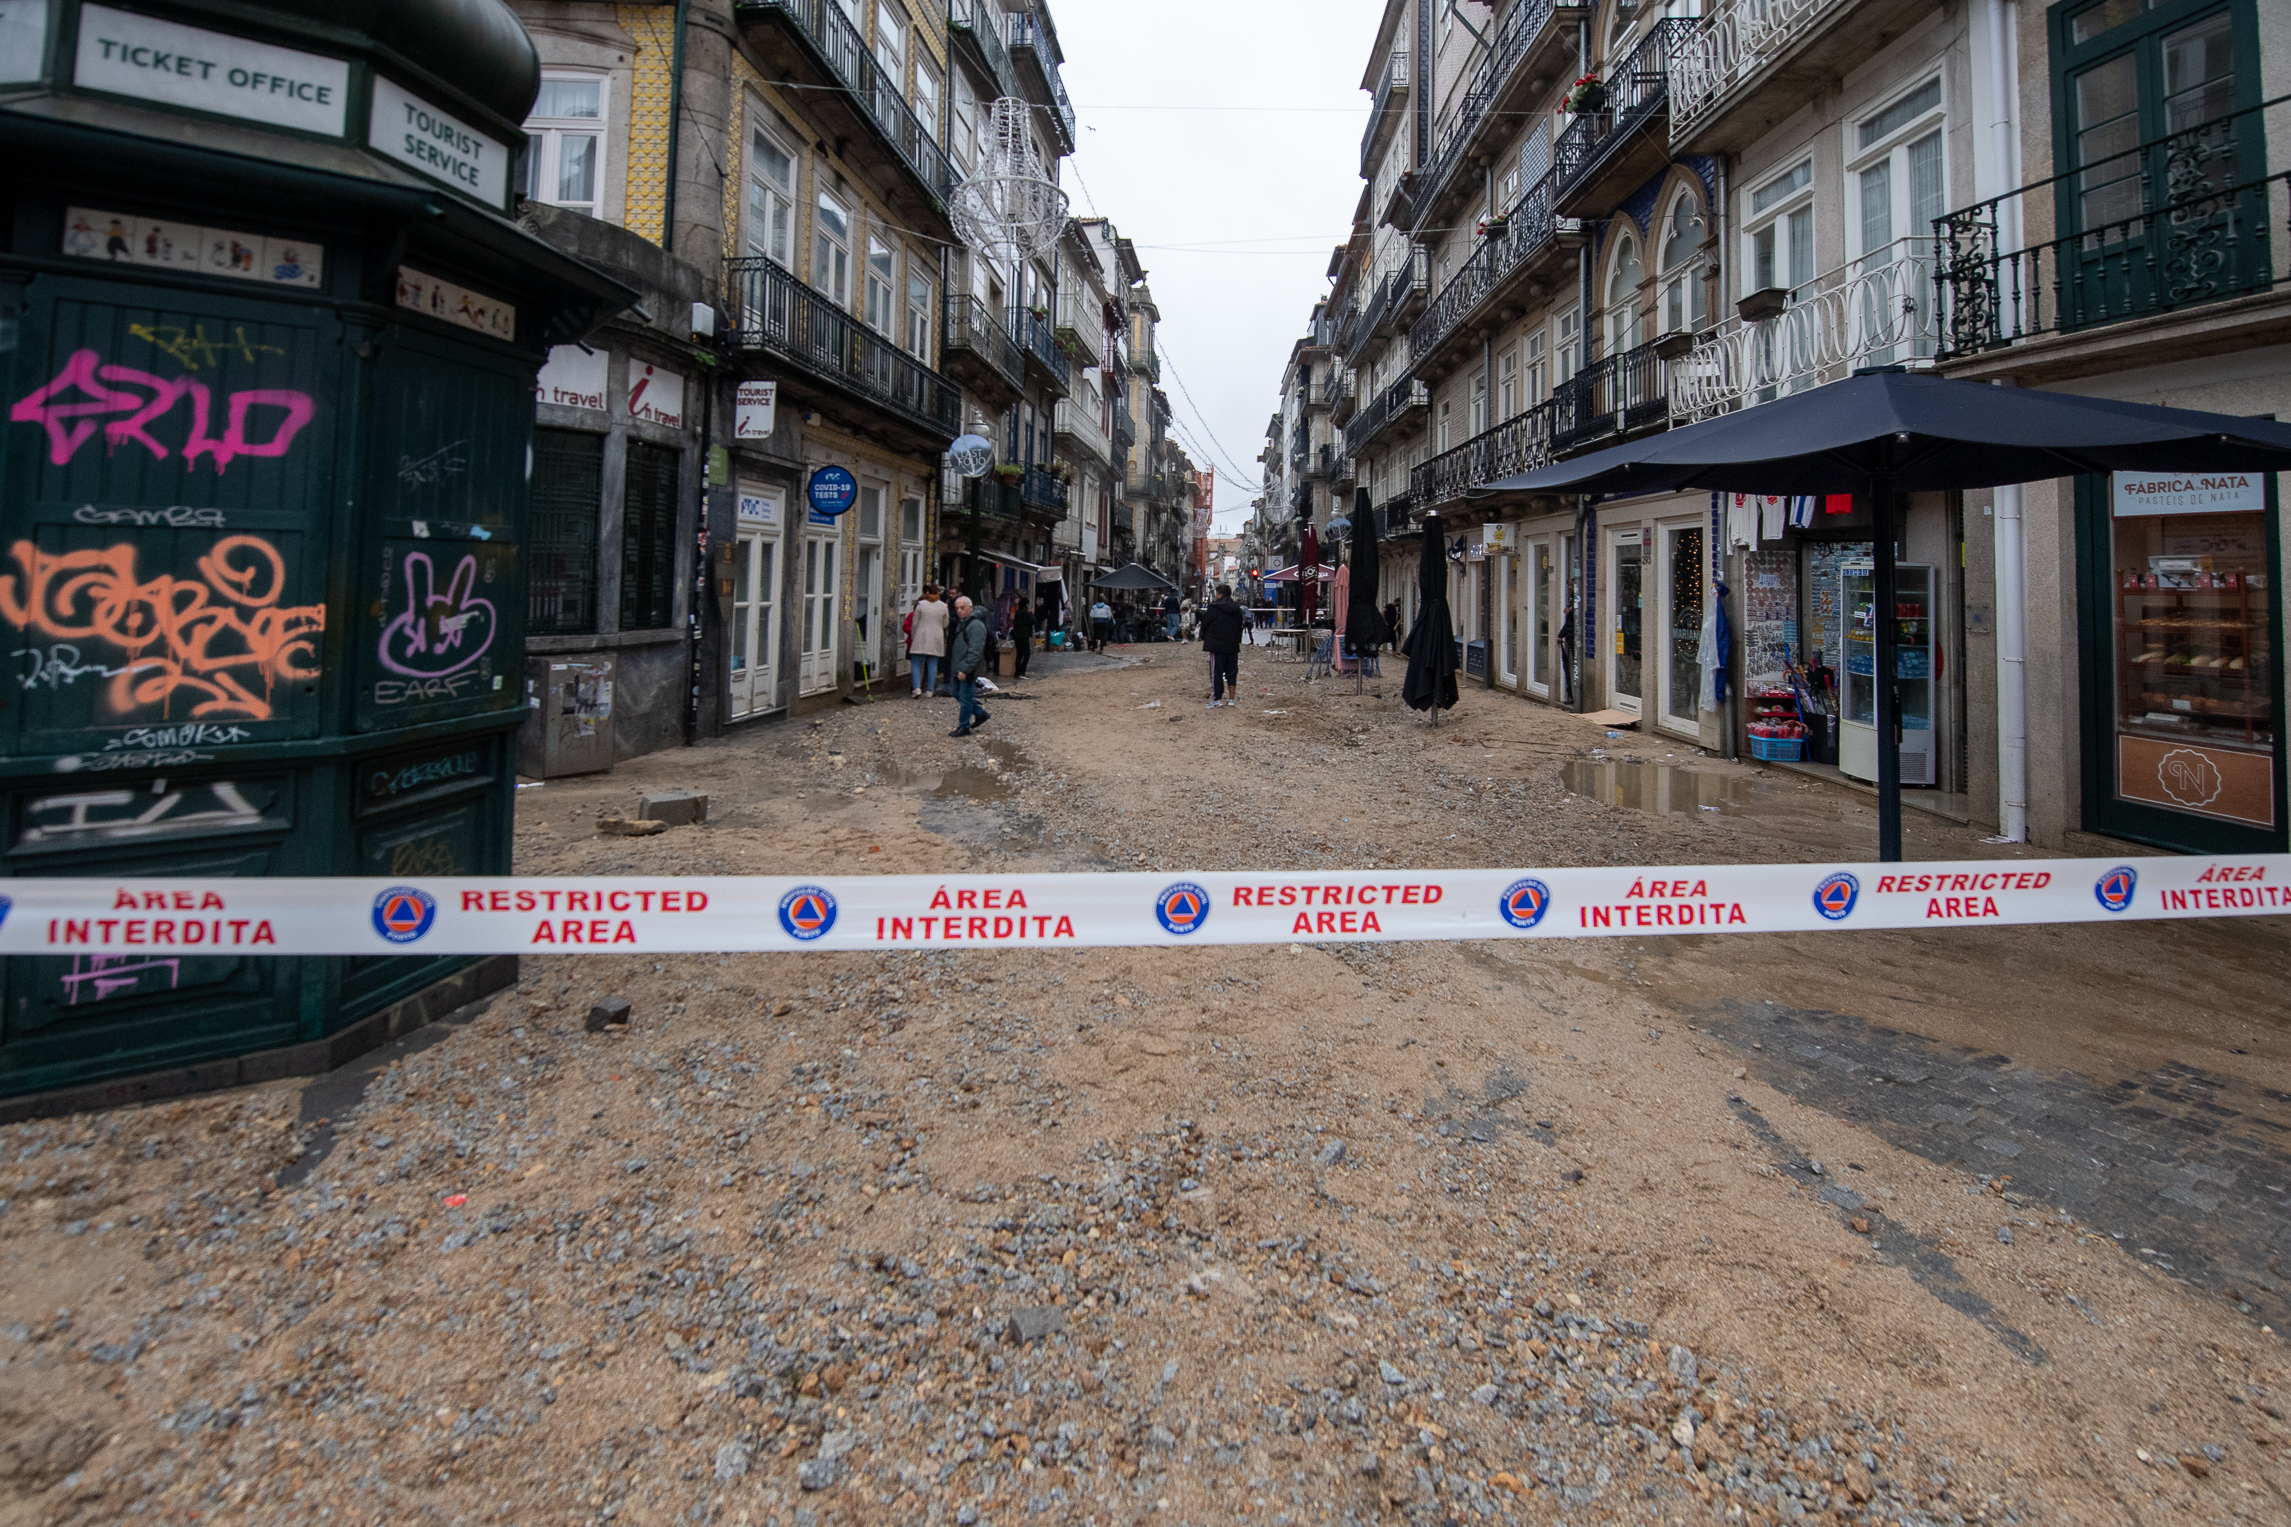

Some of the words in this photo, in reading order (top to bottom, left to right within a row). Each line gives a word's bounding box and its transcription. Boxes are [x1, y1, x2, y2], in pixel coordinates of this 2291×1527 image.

[97, 38, 217, 80] TICKET
[227, 67, 333, 106] OFFICE
[403, 102, 483, 160] TOURIST
[404, 133, 479, 187] SERVICE
[553, 386, 604, 409] travel
[737, 397, 771, 406] SERVICE
[738, 388, 775, 397] TOURIST
[655, 408, 681, 428] travel
[958, 457, 987, 466] FOLIO
[961, 448, 983, 459] LAST
[814, 483, 851, 491] COVID-19
[814, 491, 839, 499] TESTS
[2124, 480, 2195, 496] FÁBRICA
[2200, 475, 2250, 491] NATA
[2138, 494, 2184, 506] PASTÉIS
[2191, 494, 2204, 505] DE
[2210, 491, 2240, 502] NATA
[1876, 872, 2052, 894] RESTRICTED
[2196, 863, 2266, 883] ÁREA
[929, 885, 1028, 910] ÁREA
[1233, 885, 1443, 907] RESTRICTED
[1625, 876, 1708, 899] ÁREA
[2160, 885, 2291, 911] INTERDITA
[461, 890, 709, 913] RESTRICTED
[1926, 896, 2000, 919] AREA
[1293, 910, 1382, 934] AREA
[1579, 903, 1747, 928] INTERDITA
[48, 919, 276, 944] INTERDITA
[532, 919, 637, 944] AREA
[876, 915, 1075, 940] INTERDITA
